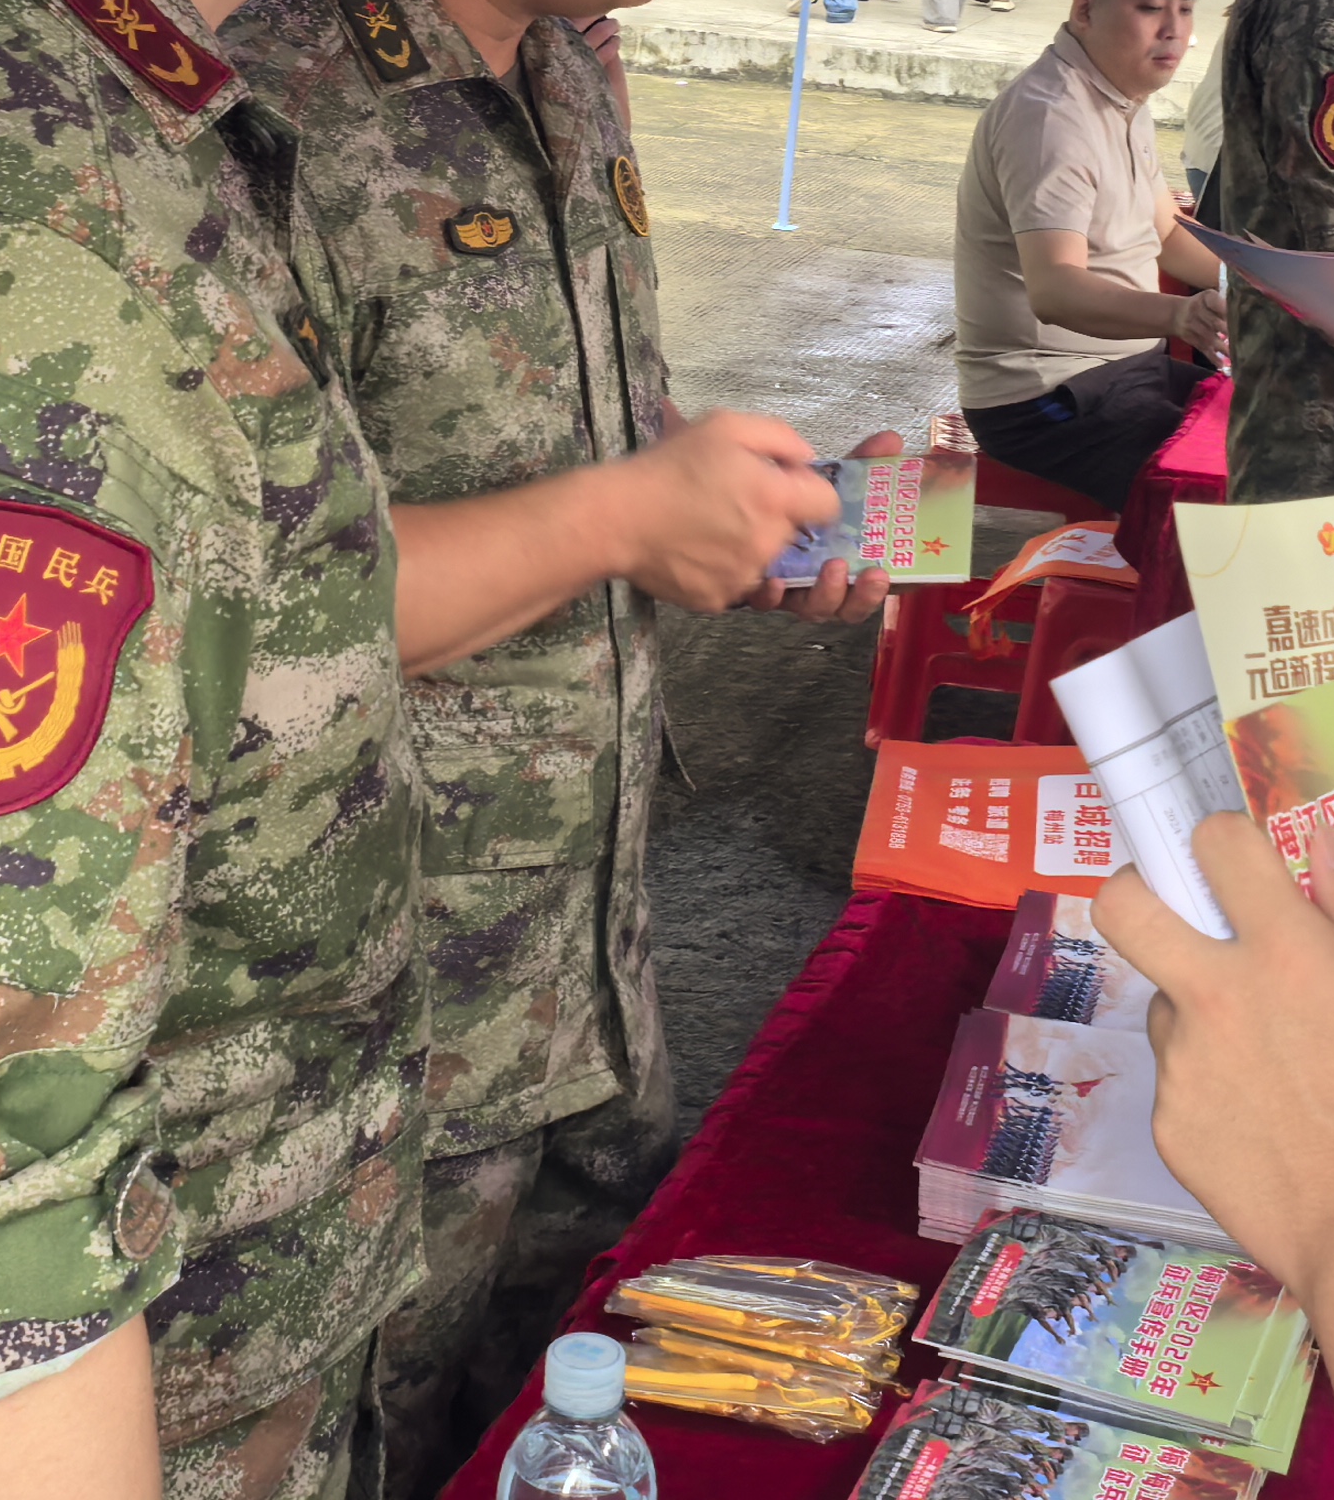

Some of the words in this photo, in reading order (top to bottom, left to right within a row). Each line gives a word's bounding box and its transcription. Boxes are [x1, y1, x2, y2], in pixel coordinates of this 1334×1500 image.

[1043, 809, 1066, 846] 梅州站
[1117, 1262, 1193, 1379] 征兵宣传手册
[1147, 1263, 1228, 1399] 梅江区2026年
